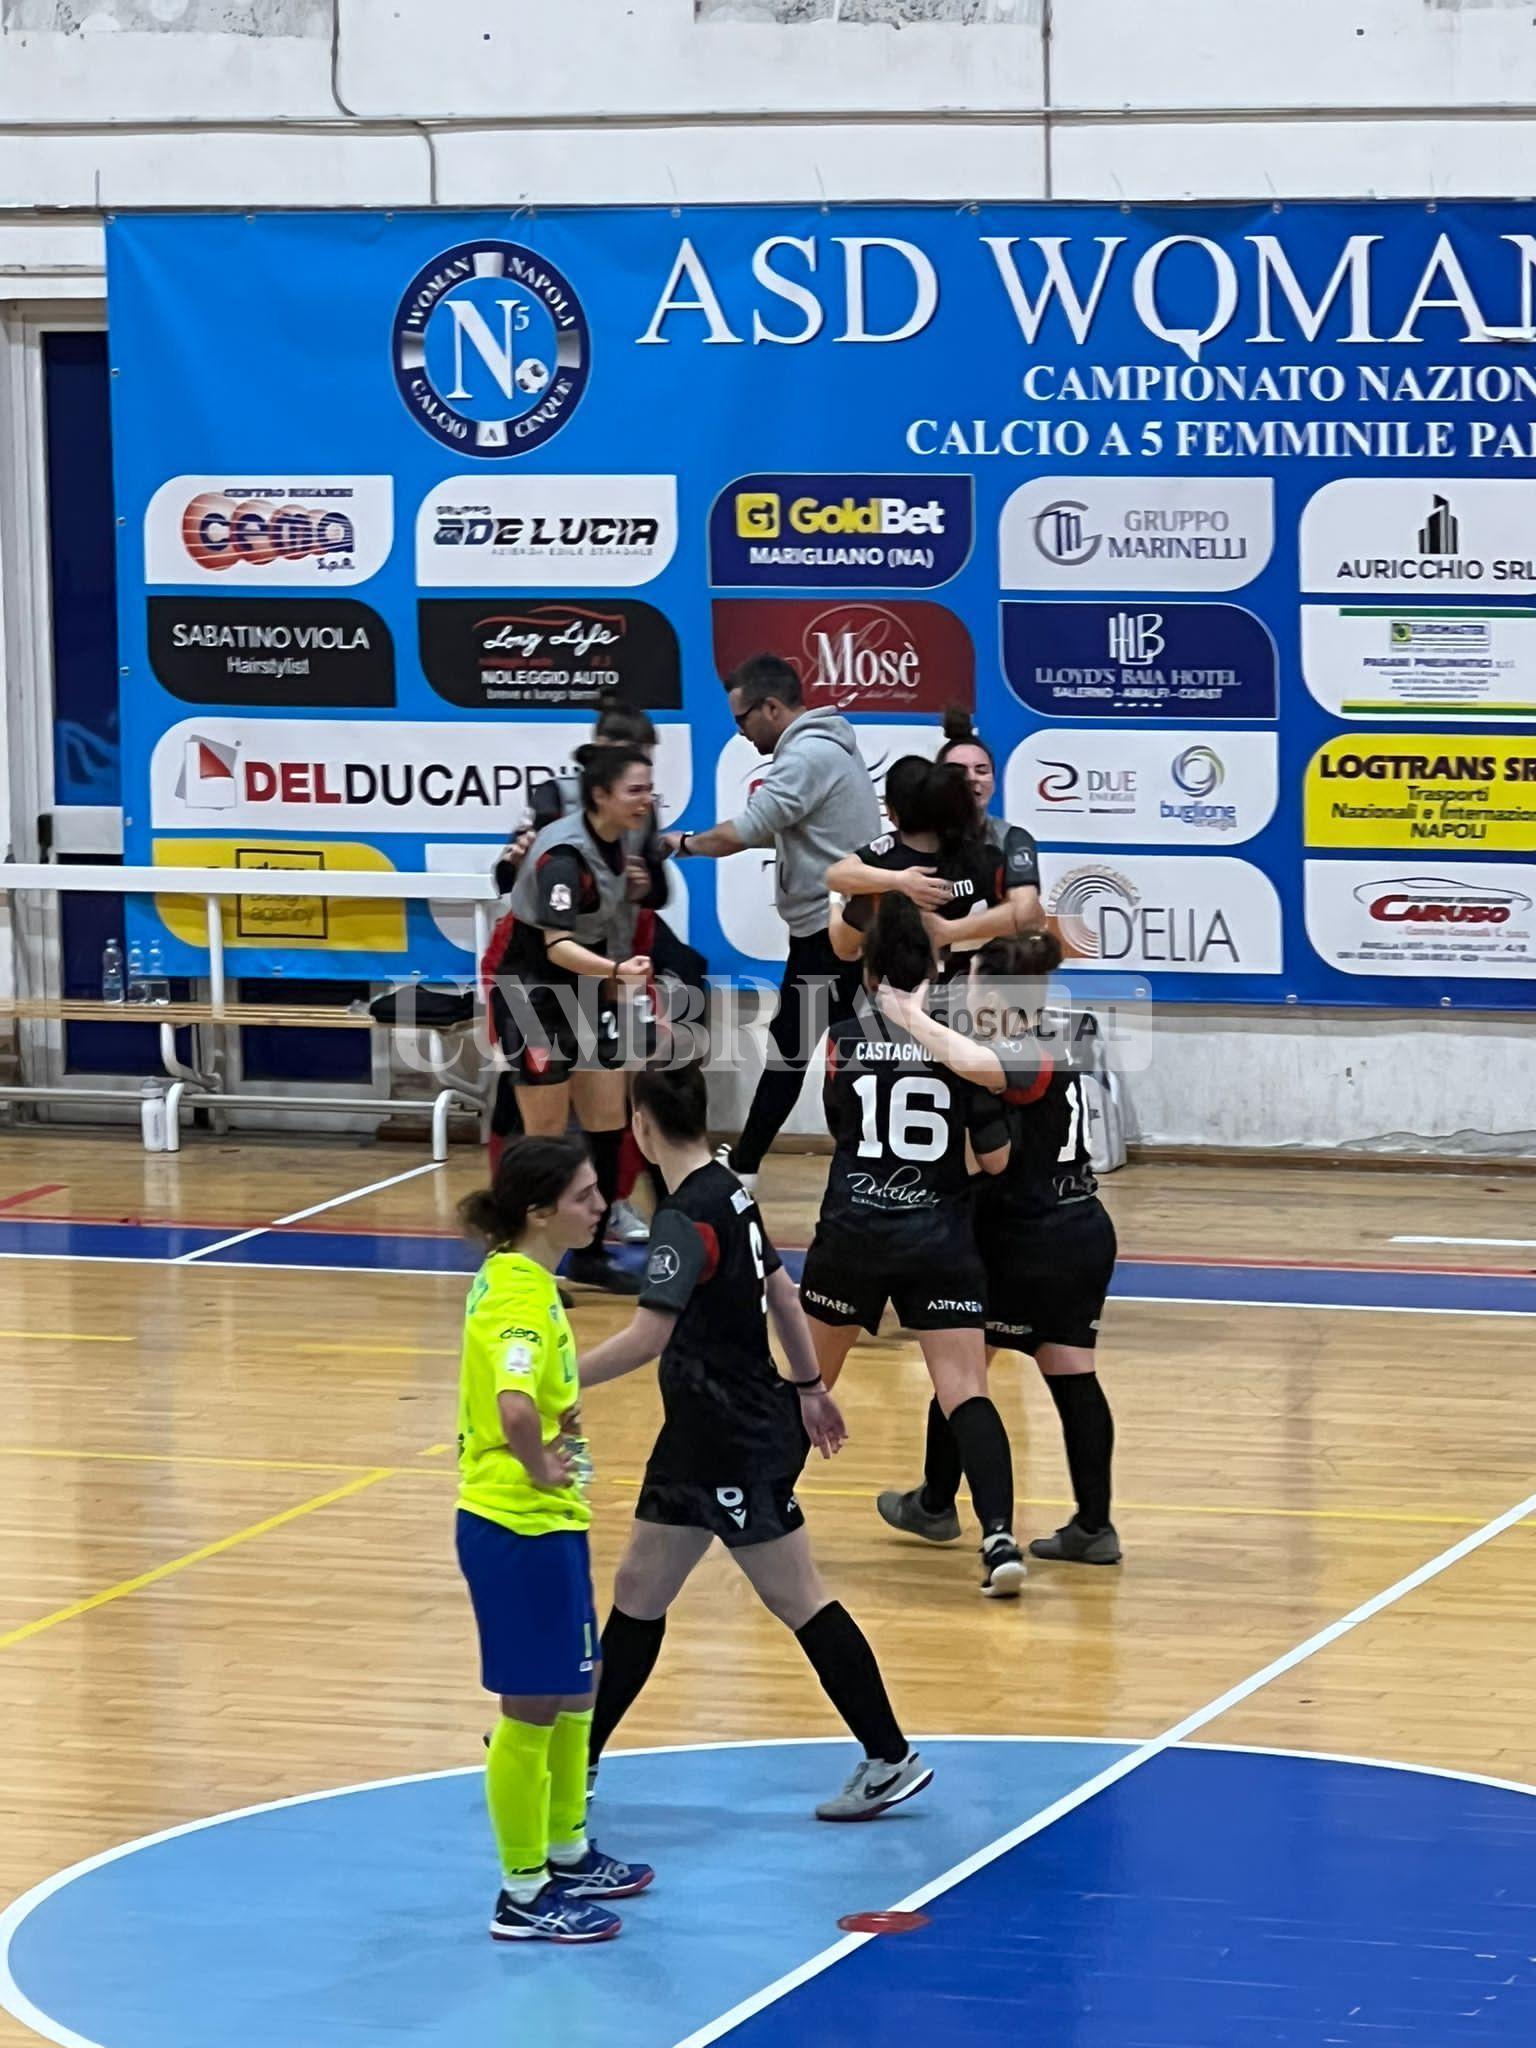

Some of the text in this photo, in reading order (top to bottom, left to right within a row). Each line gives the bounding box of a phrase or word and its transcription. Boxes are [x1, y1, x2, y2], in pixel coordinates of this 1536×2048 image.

[407, 256, 575, 327] WOMAN NAPOLI
[636, 235, 939, 344] ASD
[514, 305, 530, 331] 5
[444, 299, 521, 400] N
[1023, 365, 1346, 401] CAMPIONATO
[411, 379, 468, 440] CALCIO
[514, 378, 574, 438] CINQUE
[906, 419, 1536, 457] CALCIO A 5 FEMMINILE PA
[788, 497, 946, 534] GoldBet
[1124, 510, 1229, 532] GRUPPO
[529, 518, 659, 545] LUCIA
[750, 547, 935, 568] MARIGLIANO (NA)
[1108, 537, 1247, 559] MARINELLI
[1337, 559, 1536, 580] AURICCHIO SRL
[171, 623, 370, 650] SABATINO VIOLA
[483, 620, 620, 657] Long Life
[227, 656, 310, 678] Hairstylist
[812, 632, 921, 687] Mosè
[481, 670, 619, 685] NOLEGGIO AUTO
[1035, 667, 1242, 686] LLOYD'S BAIA HOTEL
[1087, 770, 1136, 792] DUE
[1319, 754, 1496, 781] LOGTRANS
[1407, 785, 1489, 807] Trasporti
[1160, 800, 1236, 823] buglione
[1331, 803, 1417, 818] Nazionali
[1422, 806, 1434, 819] e
[1410, 823, 1487, 838] NAPOLI
[1099, 906, 1240, 963] D'ELIA
[852, 1074, 951, 1162] 16
